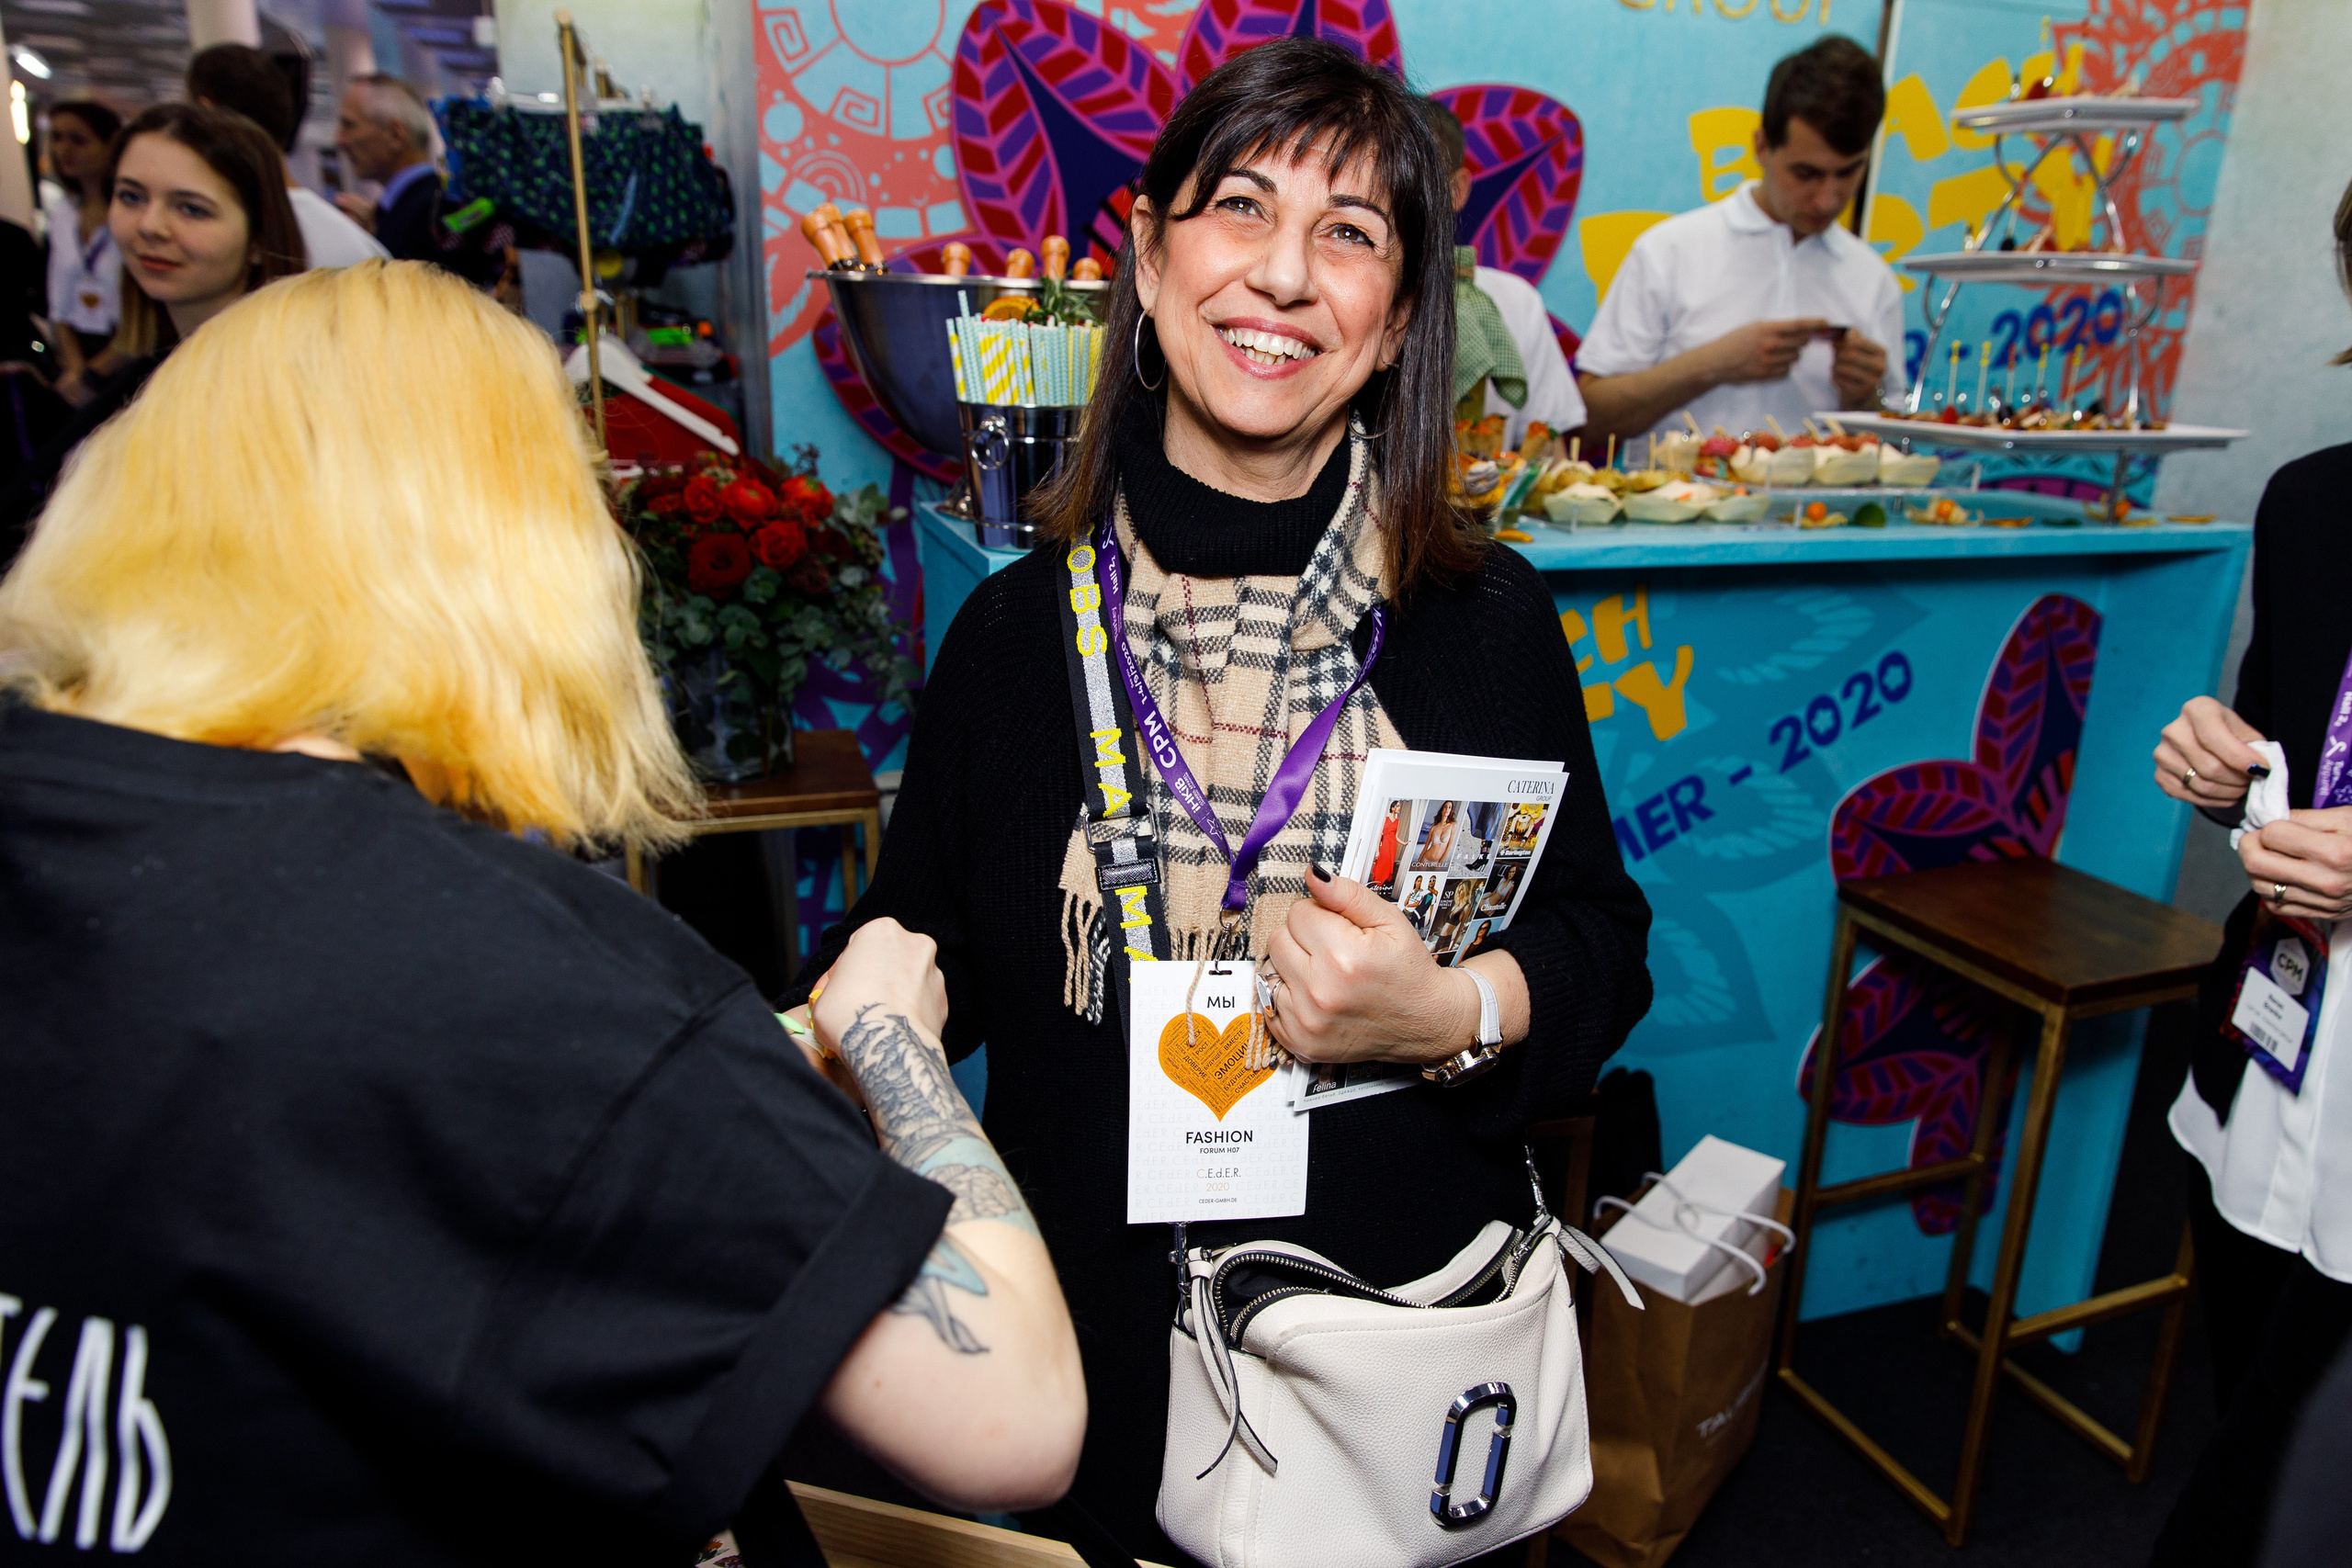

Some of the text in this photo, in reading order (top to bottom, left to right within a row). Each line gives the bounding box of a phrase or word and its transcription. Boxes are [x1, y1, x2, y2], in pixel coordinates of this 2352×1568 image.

[1769, 649, 1913, 773] 2020
[1143, 710, 1177, 768] CPM
[1508, 779, 1555, 795] CATERINA
[2277, 953, 2304, 982] CPM
[1207, 996, 1235, 1009] МЫ
[1223, 1029, 1245, 1051] ВМЕСТЕ
[1195, 1042, 1209, 1055] РОСТ
[1182, 1055, 1208, 1079] ДОВЕРИЕ
[1312, 1081, 1337, 1093] felina
[1185, 1130, 1253, 1145] FASHION
[1196, 1168, 1241, 1179] C.E.d.E.R.
[1206, 1182, 1229, 1192] 2020
